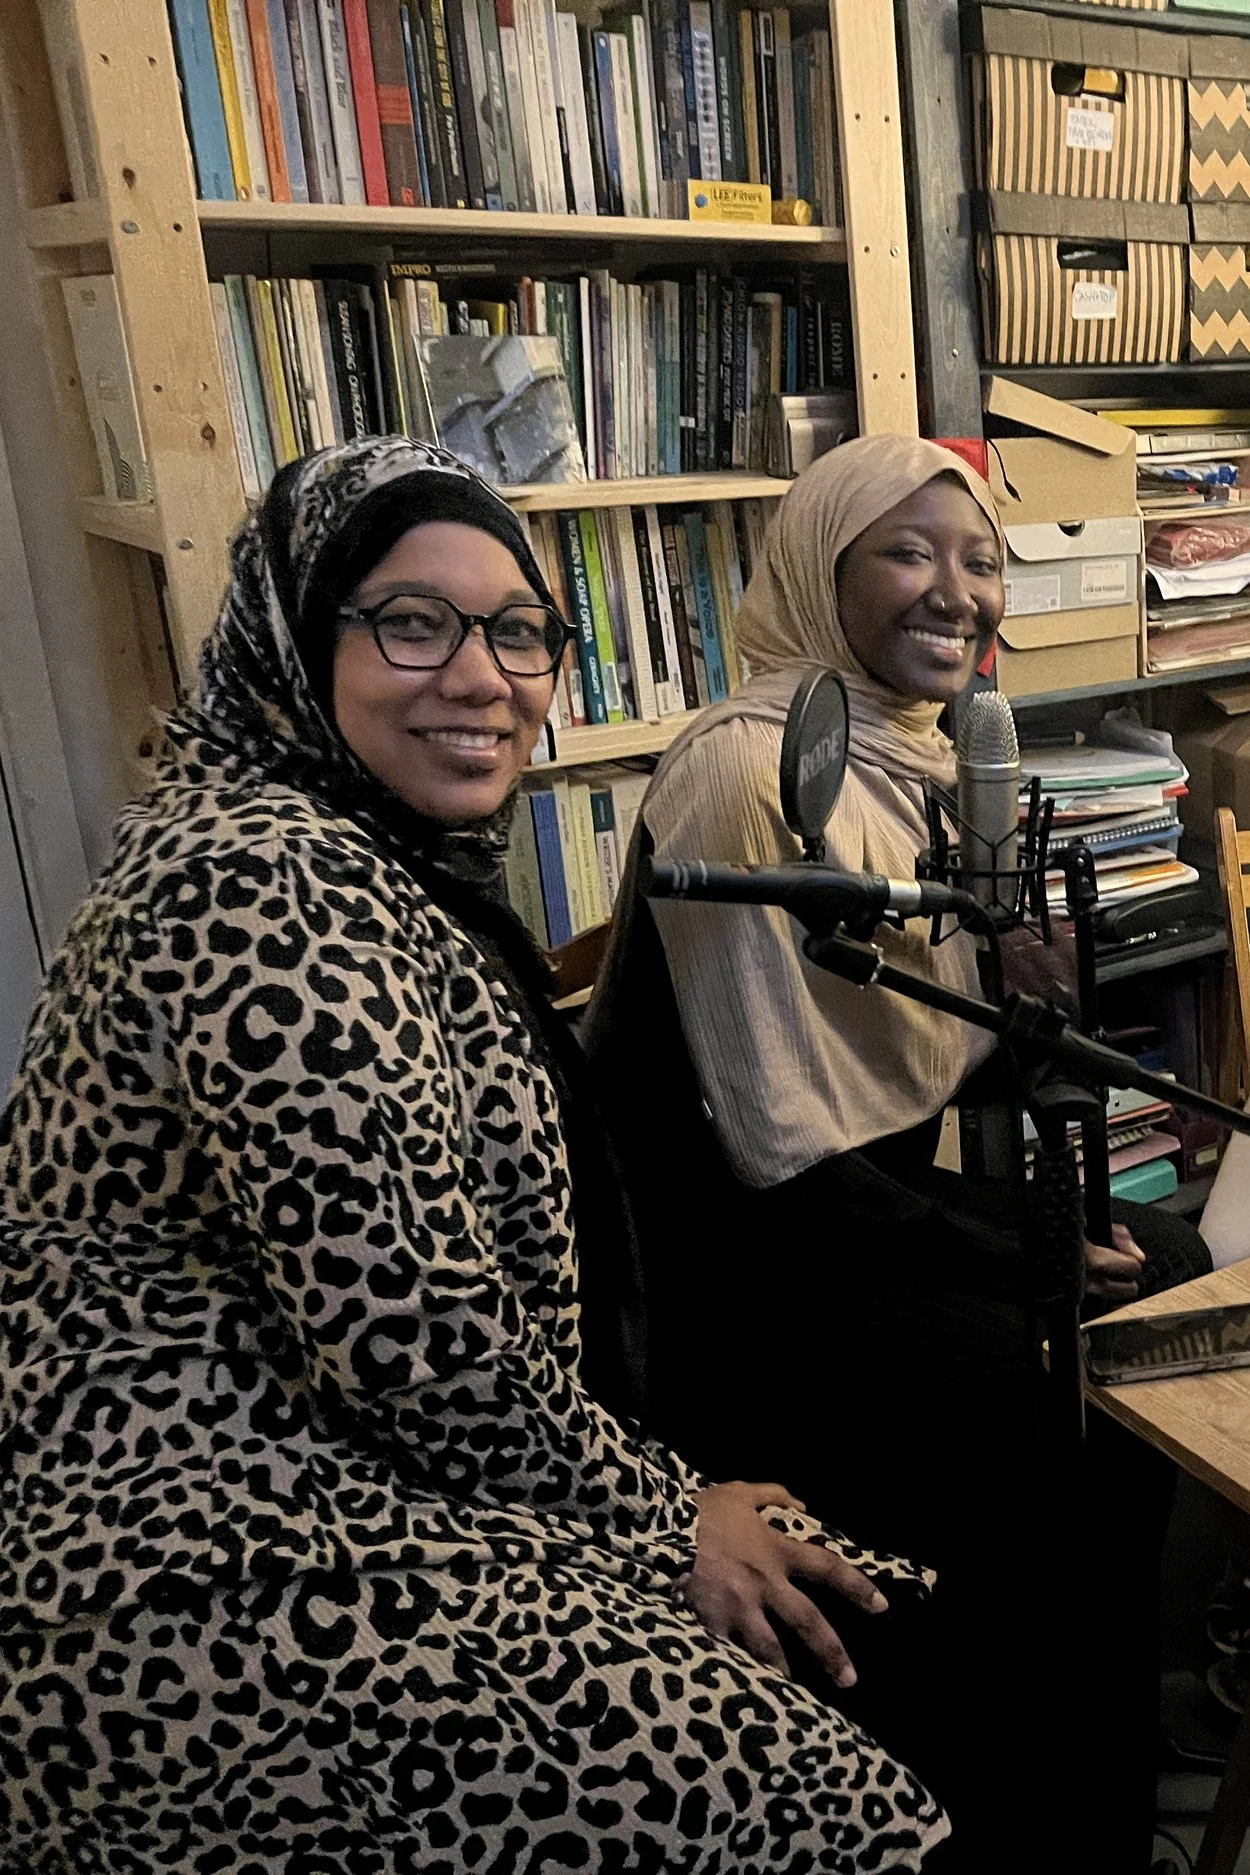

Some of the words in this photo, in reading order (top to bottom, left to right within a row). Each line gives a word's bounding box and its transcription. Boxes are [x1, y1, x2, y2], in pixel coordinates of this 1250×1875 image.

[391, 264, 431, 276] IMPRO
[567, 519, 582, 565] WOMEN
[573, 565, 584, 576] &
[575, 577, 589, 607] SOAP
[579, 607, 595, 644] OPERA
